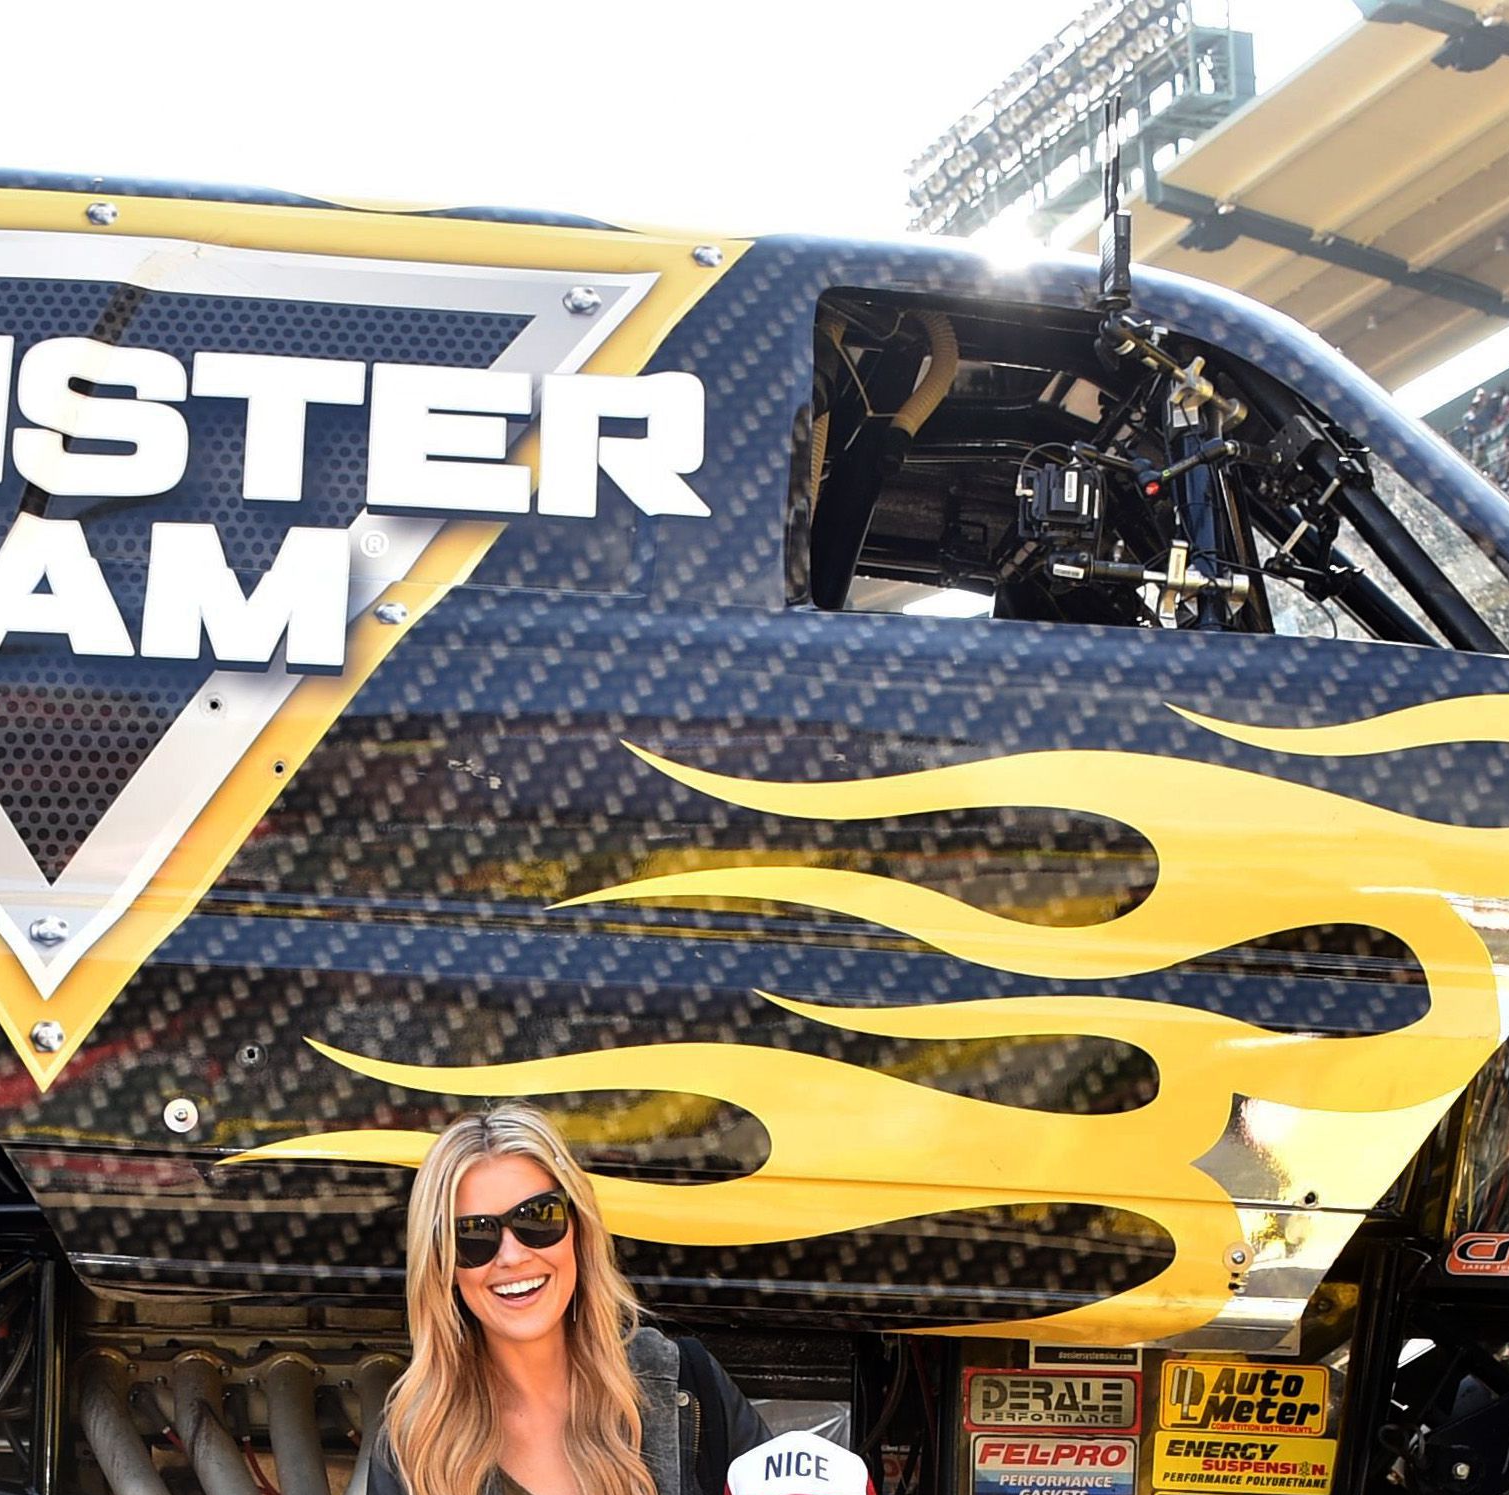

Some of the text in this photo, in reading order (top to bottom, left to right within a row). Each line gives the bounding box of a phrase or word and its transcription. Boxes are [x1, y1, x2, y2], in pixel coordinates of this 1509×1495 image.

[1211, 1368, 1304, 1398] Auto
[982, 1379, 1123, 1412] DERALE
[982, 1412, 1123, 1424] PERFORMANCE
[1200, 1395, 1320, 1428] Meter
[978, 1443, 1128, 1467] FEL-PRO
[1165, 1440, 1280, 1461] ENERGY
[763, 1451, 830, 1483] NICE
[999, 1474, 1113, 1488] PERFORMANCE
[1162, 1472, 1329, 1488] PERFORMANCE POLYURETHANE
